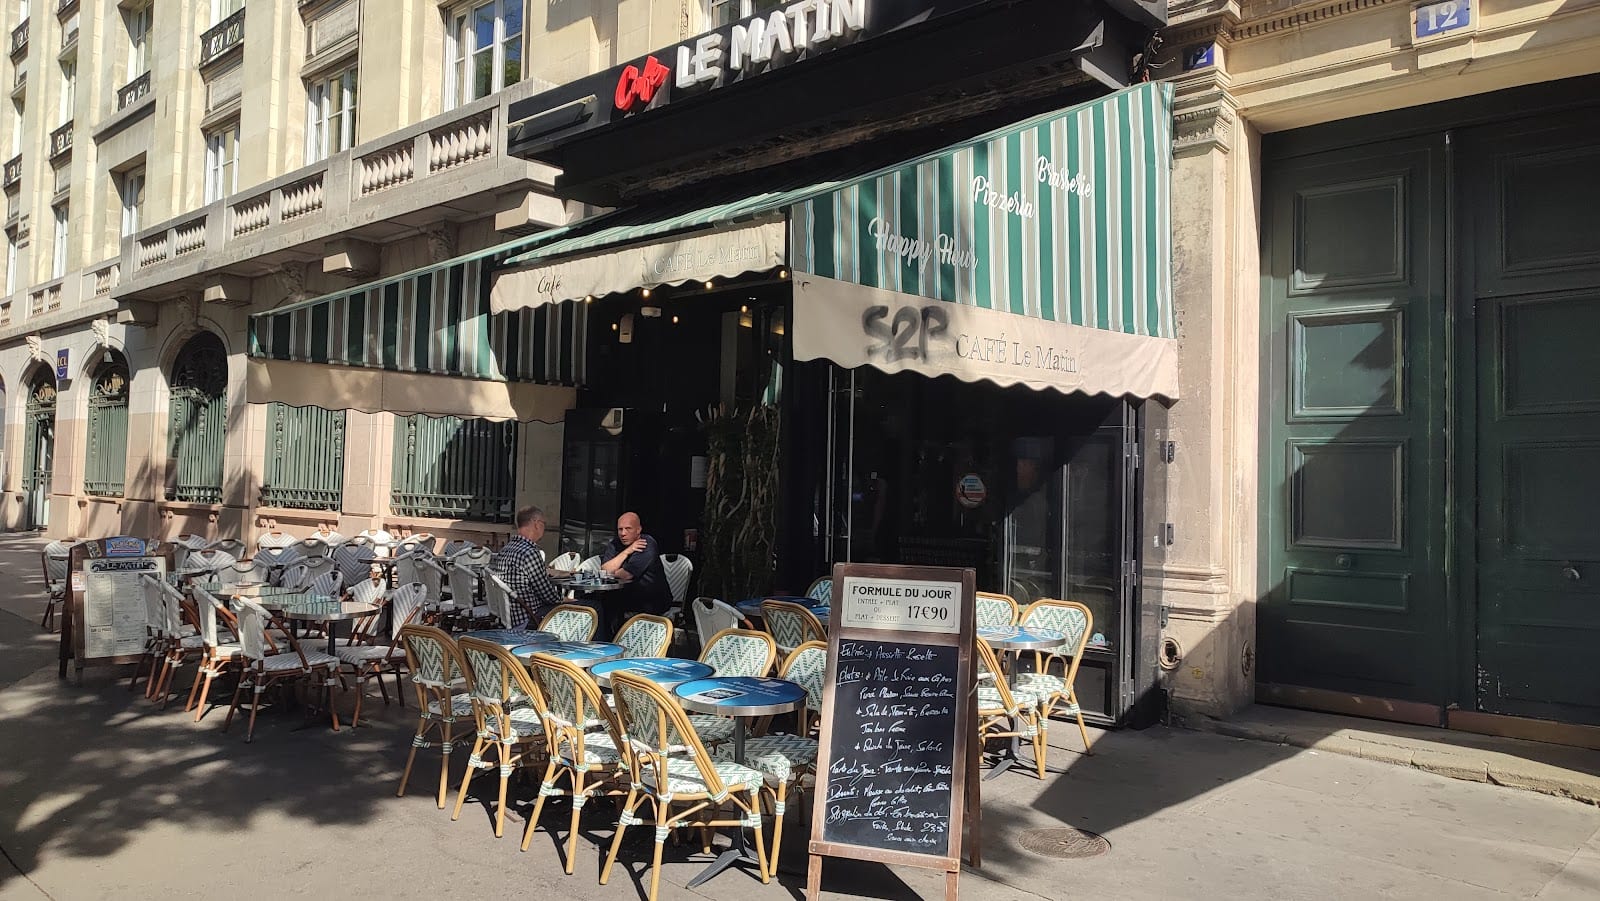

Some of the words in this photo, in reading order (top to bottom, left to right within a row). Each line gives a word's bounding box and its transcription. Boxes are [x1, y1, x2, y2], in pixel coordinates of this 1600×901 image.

[1427, 4, 1458, 31] 12
[676, 33, 723, 88] LE
[730, 0, 864, 70] MATIN
[1036, 156, 1093, 198] Brasserie
[973, 176, 1035, 218] Pizzeria
[697, 251, 715, 267] Le
[718, 246, 759, 266] Matin
[868, 217, 933, 273] Happy
[934, 233, 979, 270] Hour
[537, 274, 562, 295] Café
[57, 357, 68, 367] LCL
[956, 333, 1007, 364] CAFÉ
[1012, 341, 1032, 366] Le
[1035, 347, 1077, 373] Matin
[852, 585, 901, 597] FORMULE
[905, 588, 920, 598] DU
[922, 590, 952, 599] JOUR
[908, 605, 948, 621] 17€90
